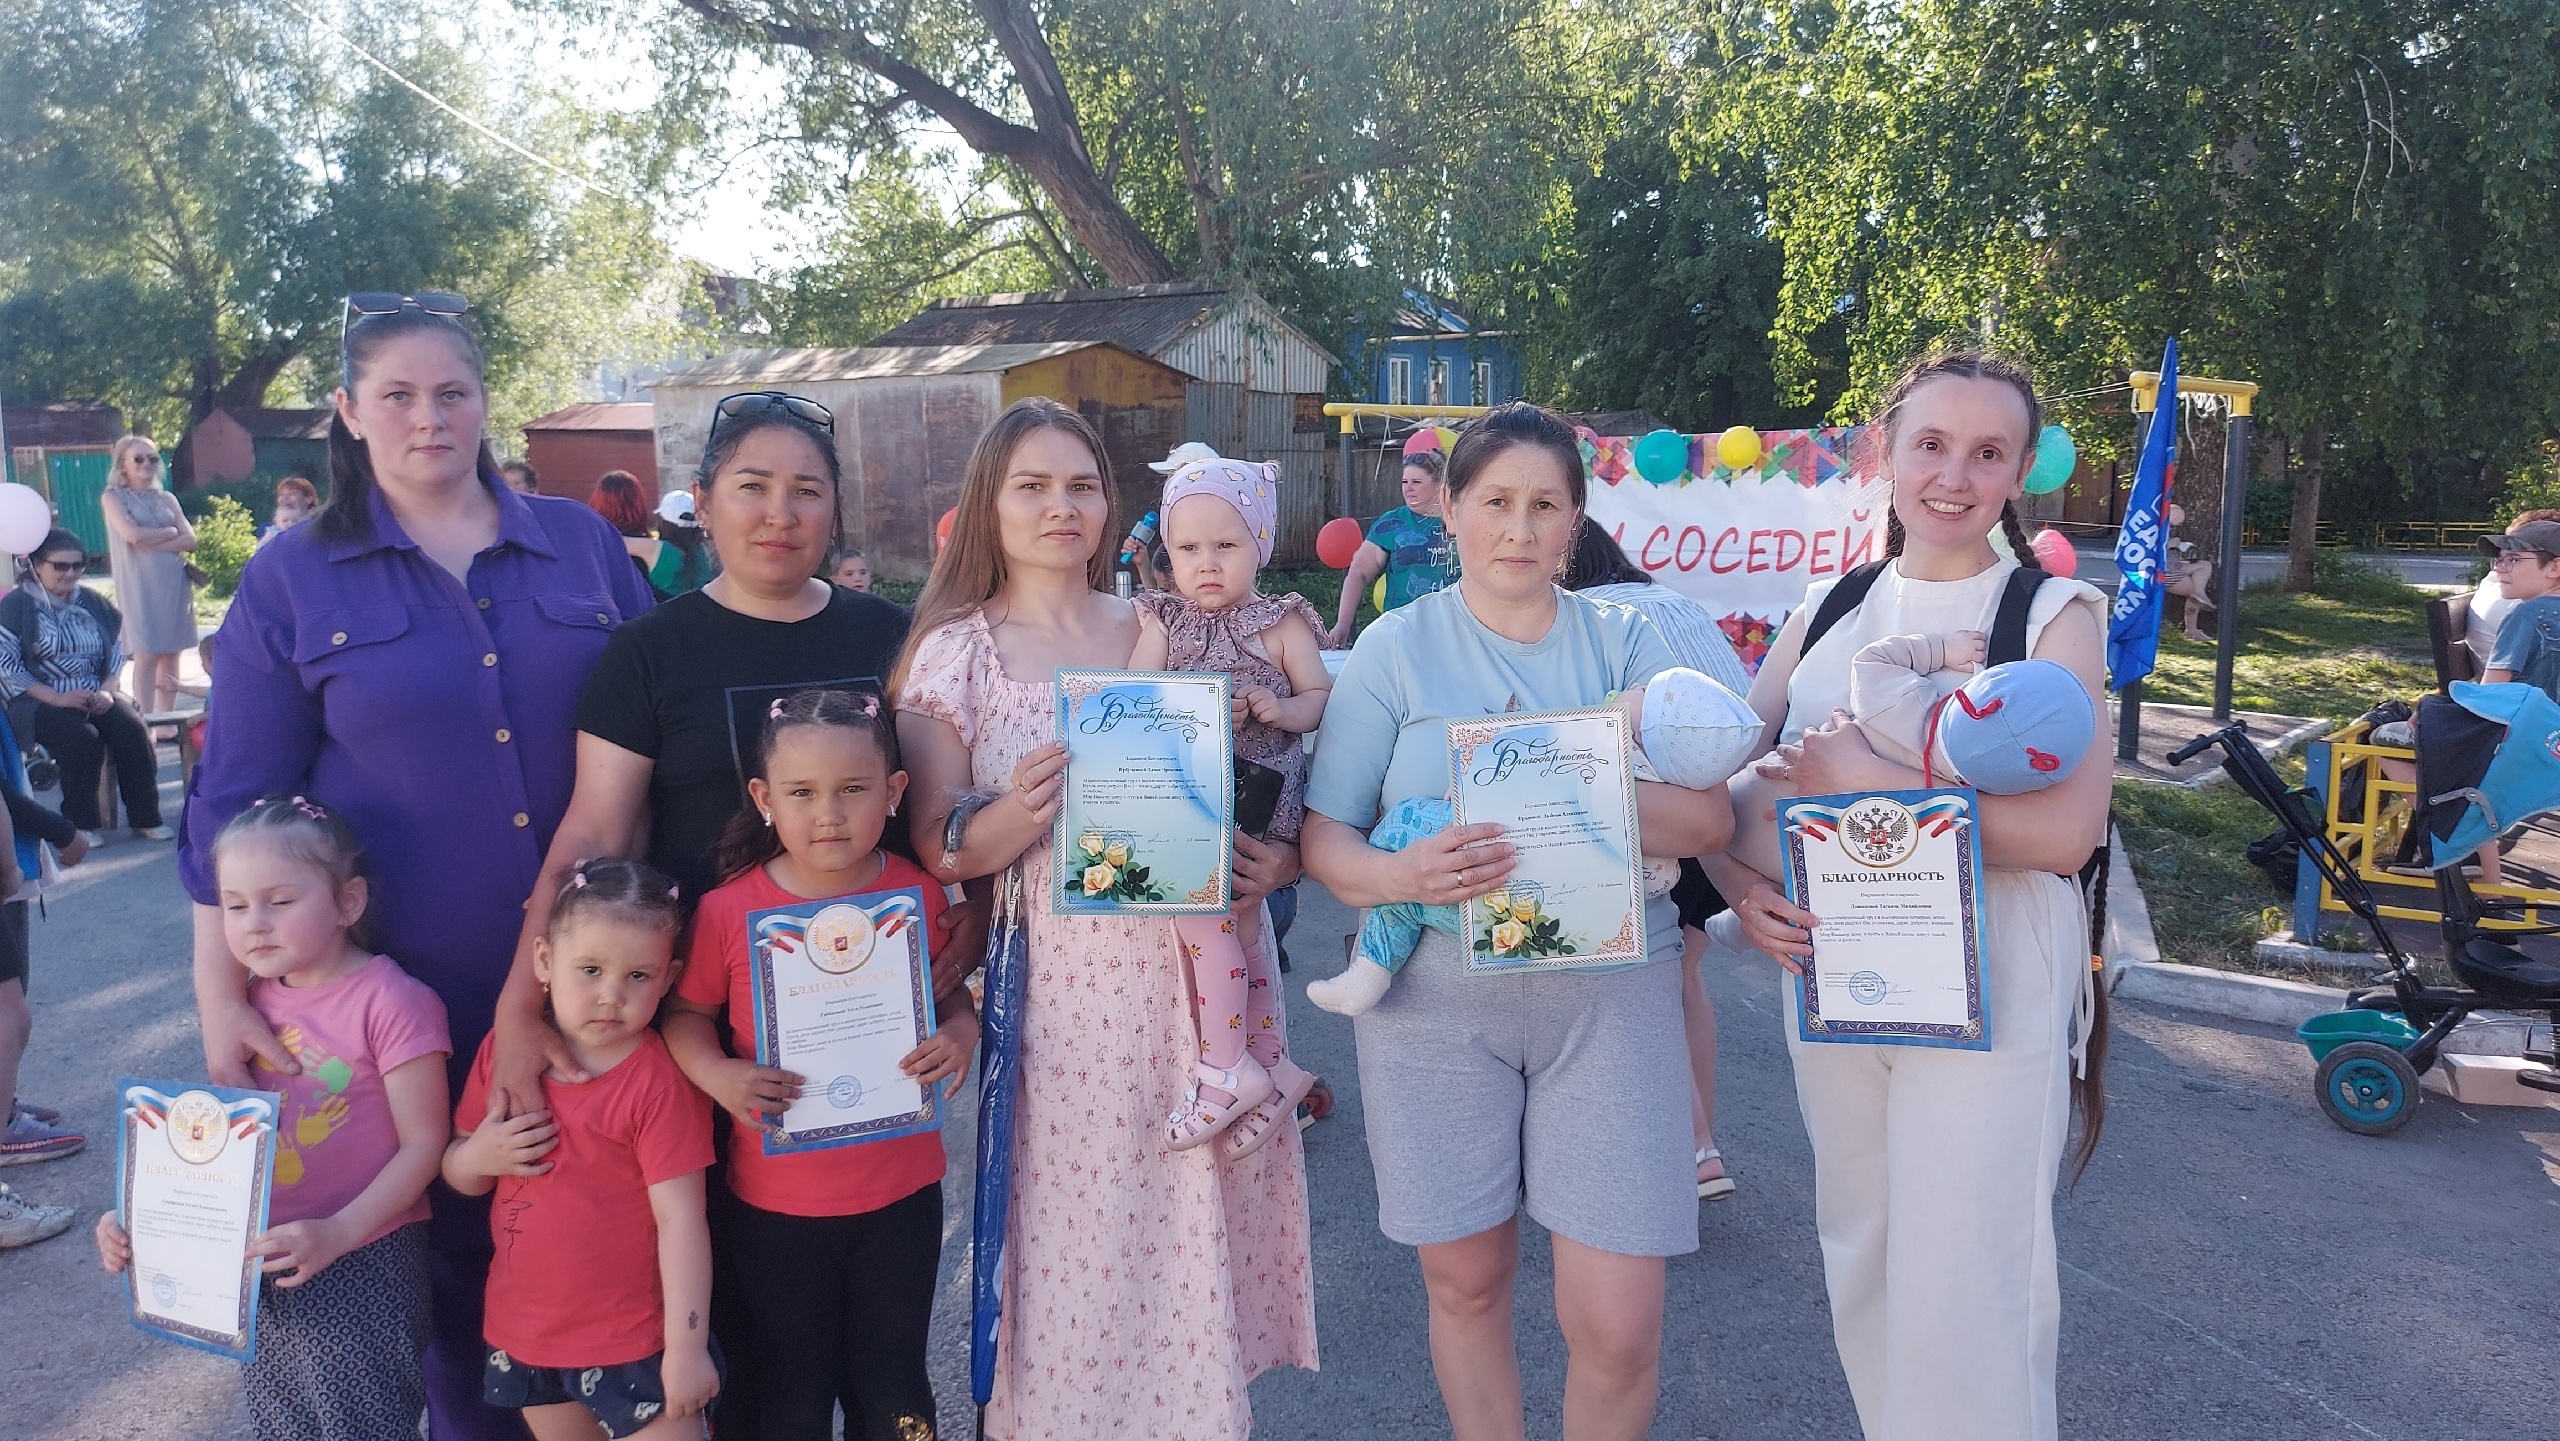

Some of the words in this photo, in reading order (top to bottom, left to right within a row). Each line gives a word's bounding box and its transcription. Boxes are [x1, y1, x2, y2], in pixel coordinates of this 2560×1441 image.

[1641, 509, 1874, 575] СОСЕДЕЙ
[1080, 692, 1210, 744] Благодарность
[1473, 737, 1609, 786] Благодарность
[1821, 871, 1945, 883] БЛАГОДАРНОСТЬ
